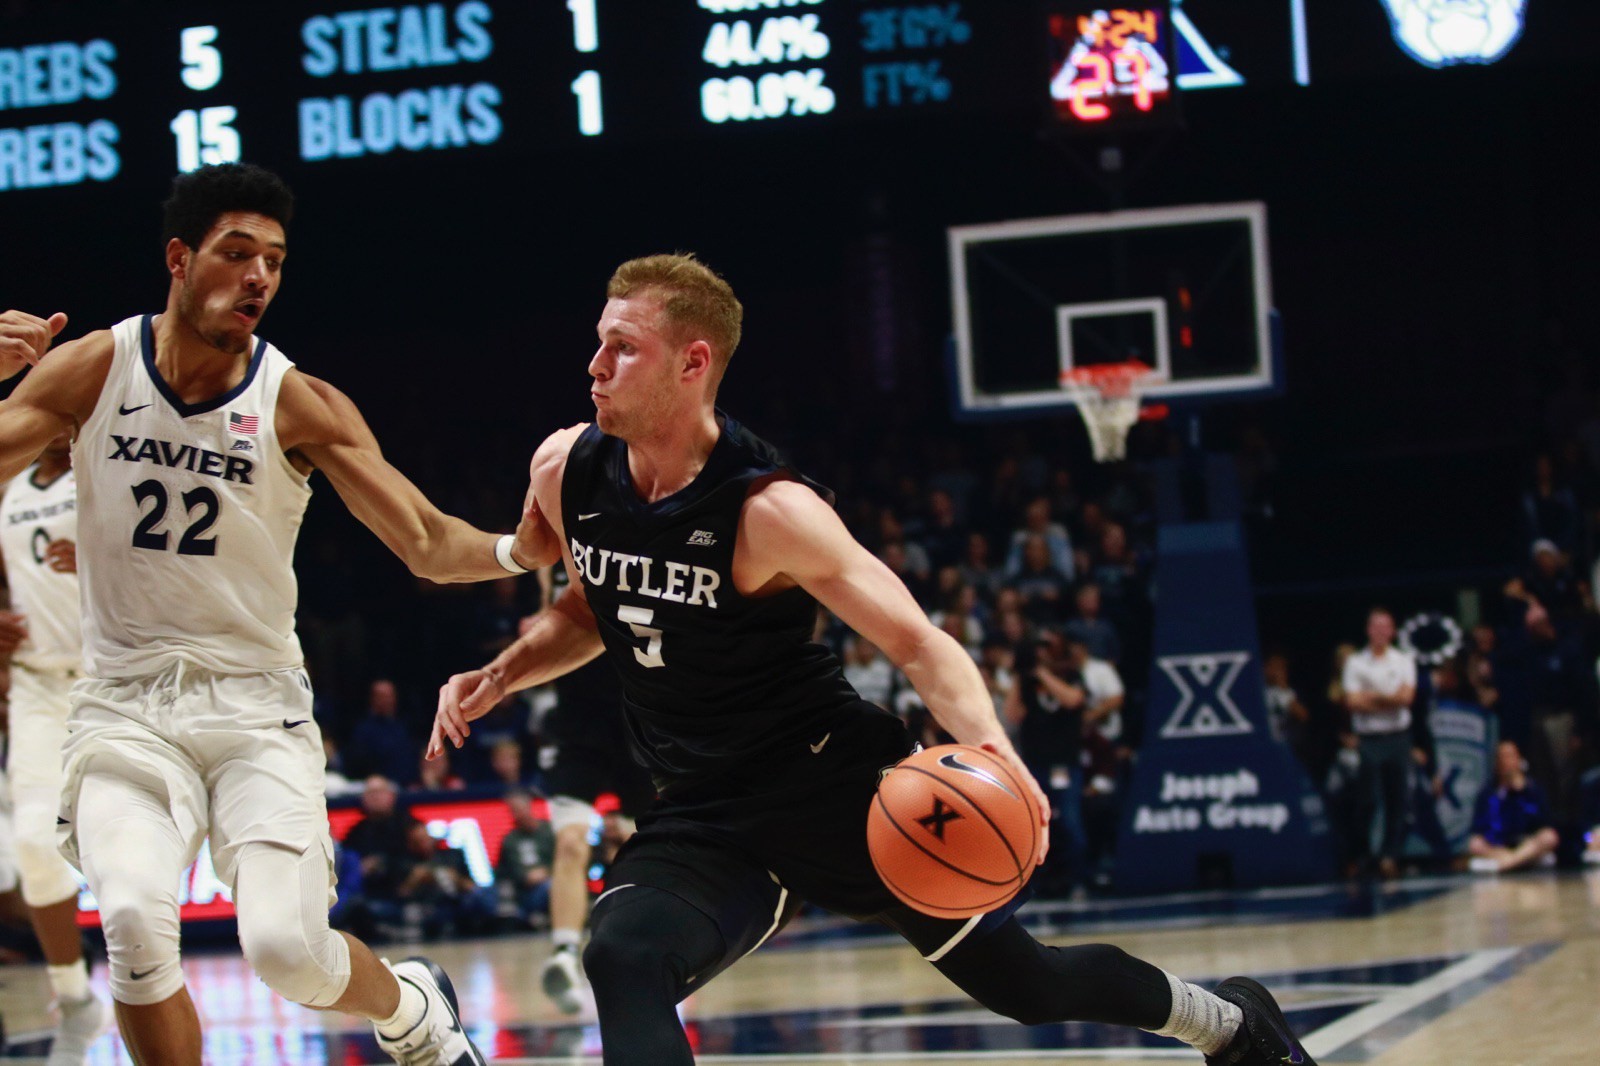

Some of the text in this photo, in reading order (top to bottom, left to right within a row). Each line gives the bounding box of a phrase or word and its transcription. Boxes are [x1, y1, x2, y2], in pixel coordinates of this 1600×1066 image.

[181, 25, 222, 90] 5
[302, 1, 492, 77] STEALS
[702, 13, 830, 68] 44.4%
[0, 39, 116, 109] REBS
[571, 70, 603, 136] 1
[863, 60, 952, 108] FT%
[170, 105, 241, 173] 15
[299, 83, 502, 161] BLOCKS
[0, 119, 120, 191] REBS
[108, 435, 255, 484] XAVIER
[131, 479, 219, 556] 22
[688, 536, 717, 545] EAST
[693, 530, 713, 538] BIG
[571, 537, 720, 609] BUTLER
[617, 604, 666, 668] 5
[1134, 803, 1289, 833] Auto Group
[1161, 769, 1259, 802] Joseph
